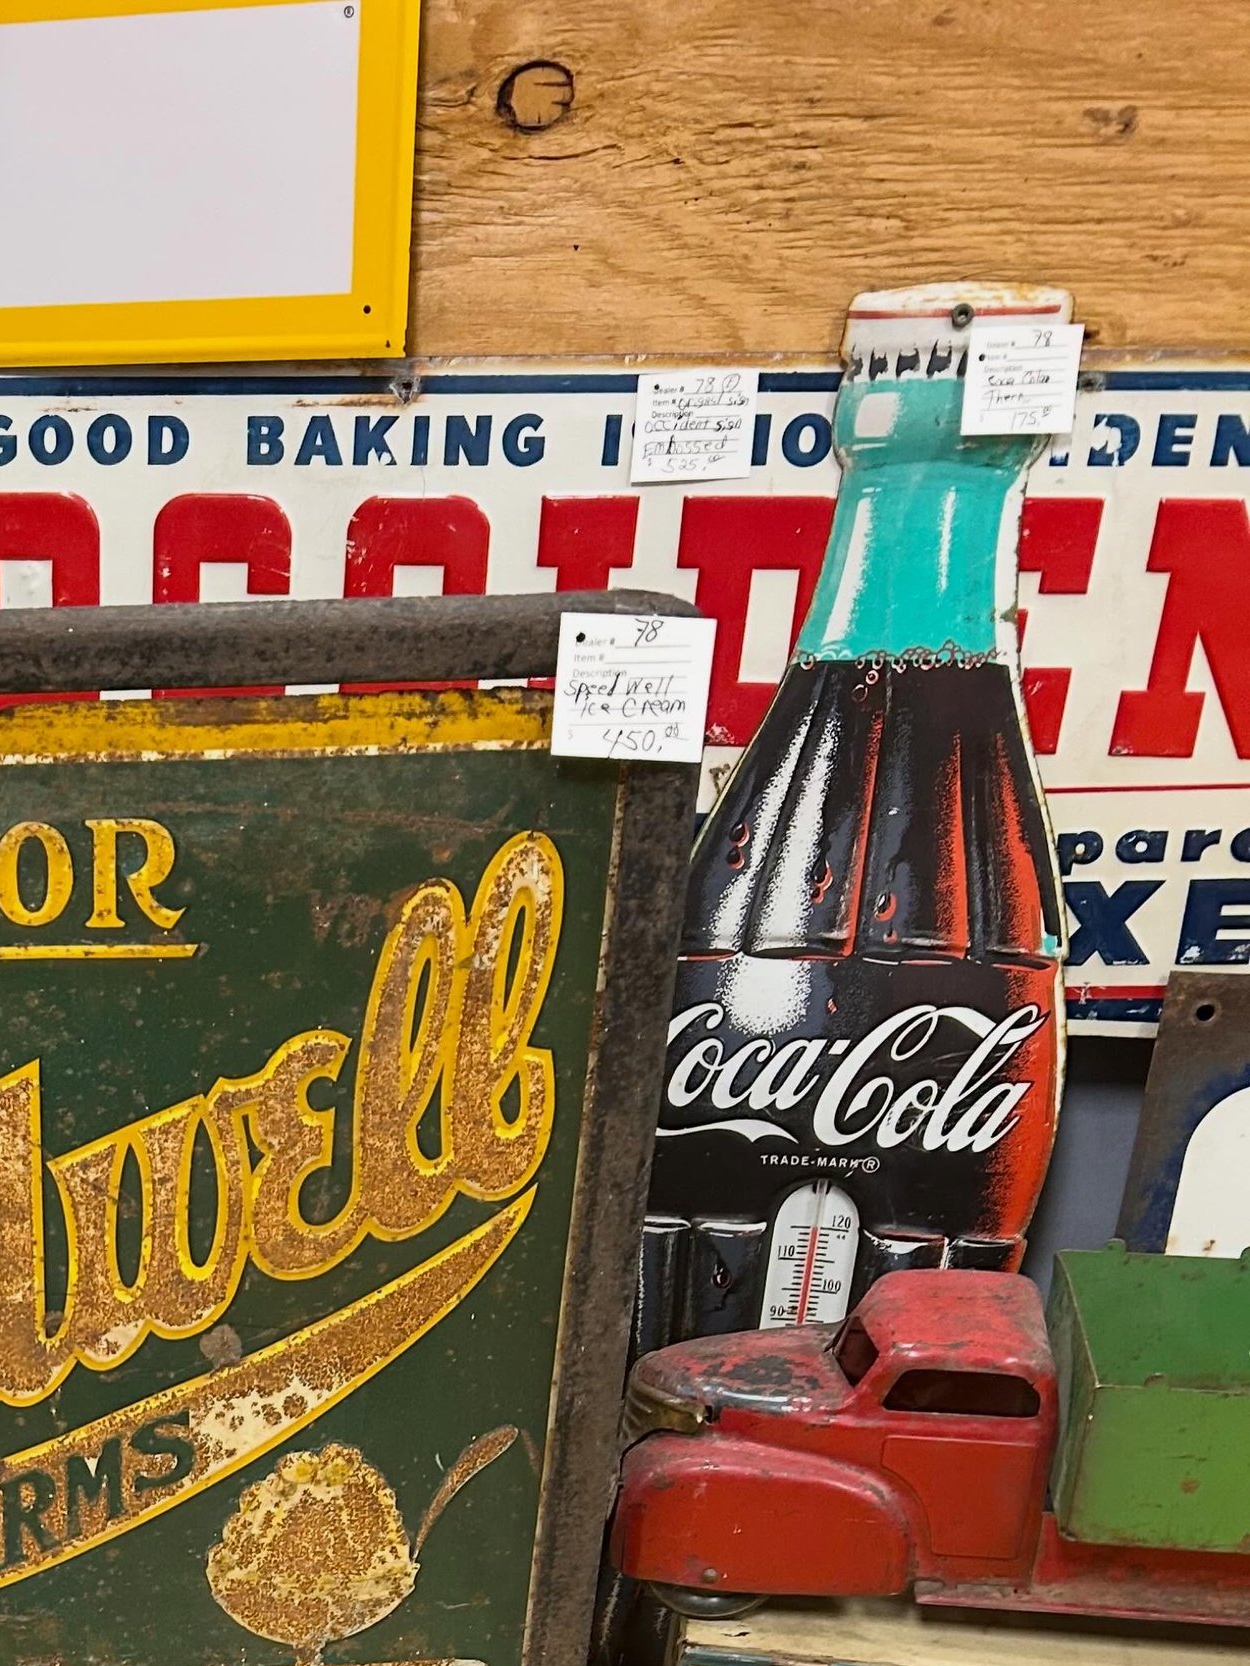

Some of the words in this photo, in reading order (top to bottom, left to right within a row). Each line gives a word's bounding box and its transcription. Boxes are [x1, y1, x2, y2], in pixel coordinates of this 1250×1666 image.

[1032, 328, 1053, 348] 78
[695, 376, 716, 395] 78
[247, 413, 546, 467] BAKING
[601, 413, 635, 467] I
[634, 618, 664, 647] 78
[573, 653, 597, 663] Item
[572, 668, 627, 679] Description
[832, 1215, 851, 1229] 120
[777, 1245, 795, 1258] 110
[822, 1278, 842, 1292] 100
[769, 1306, 784, 1317] 90
